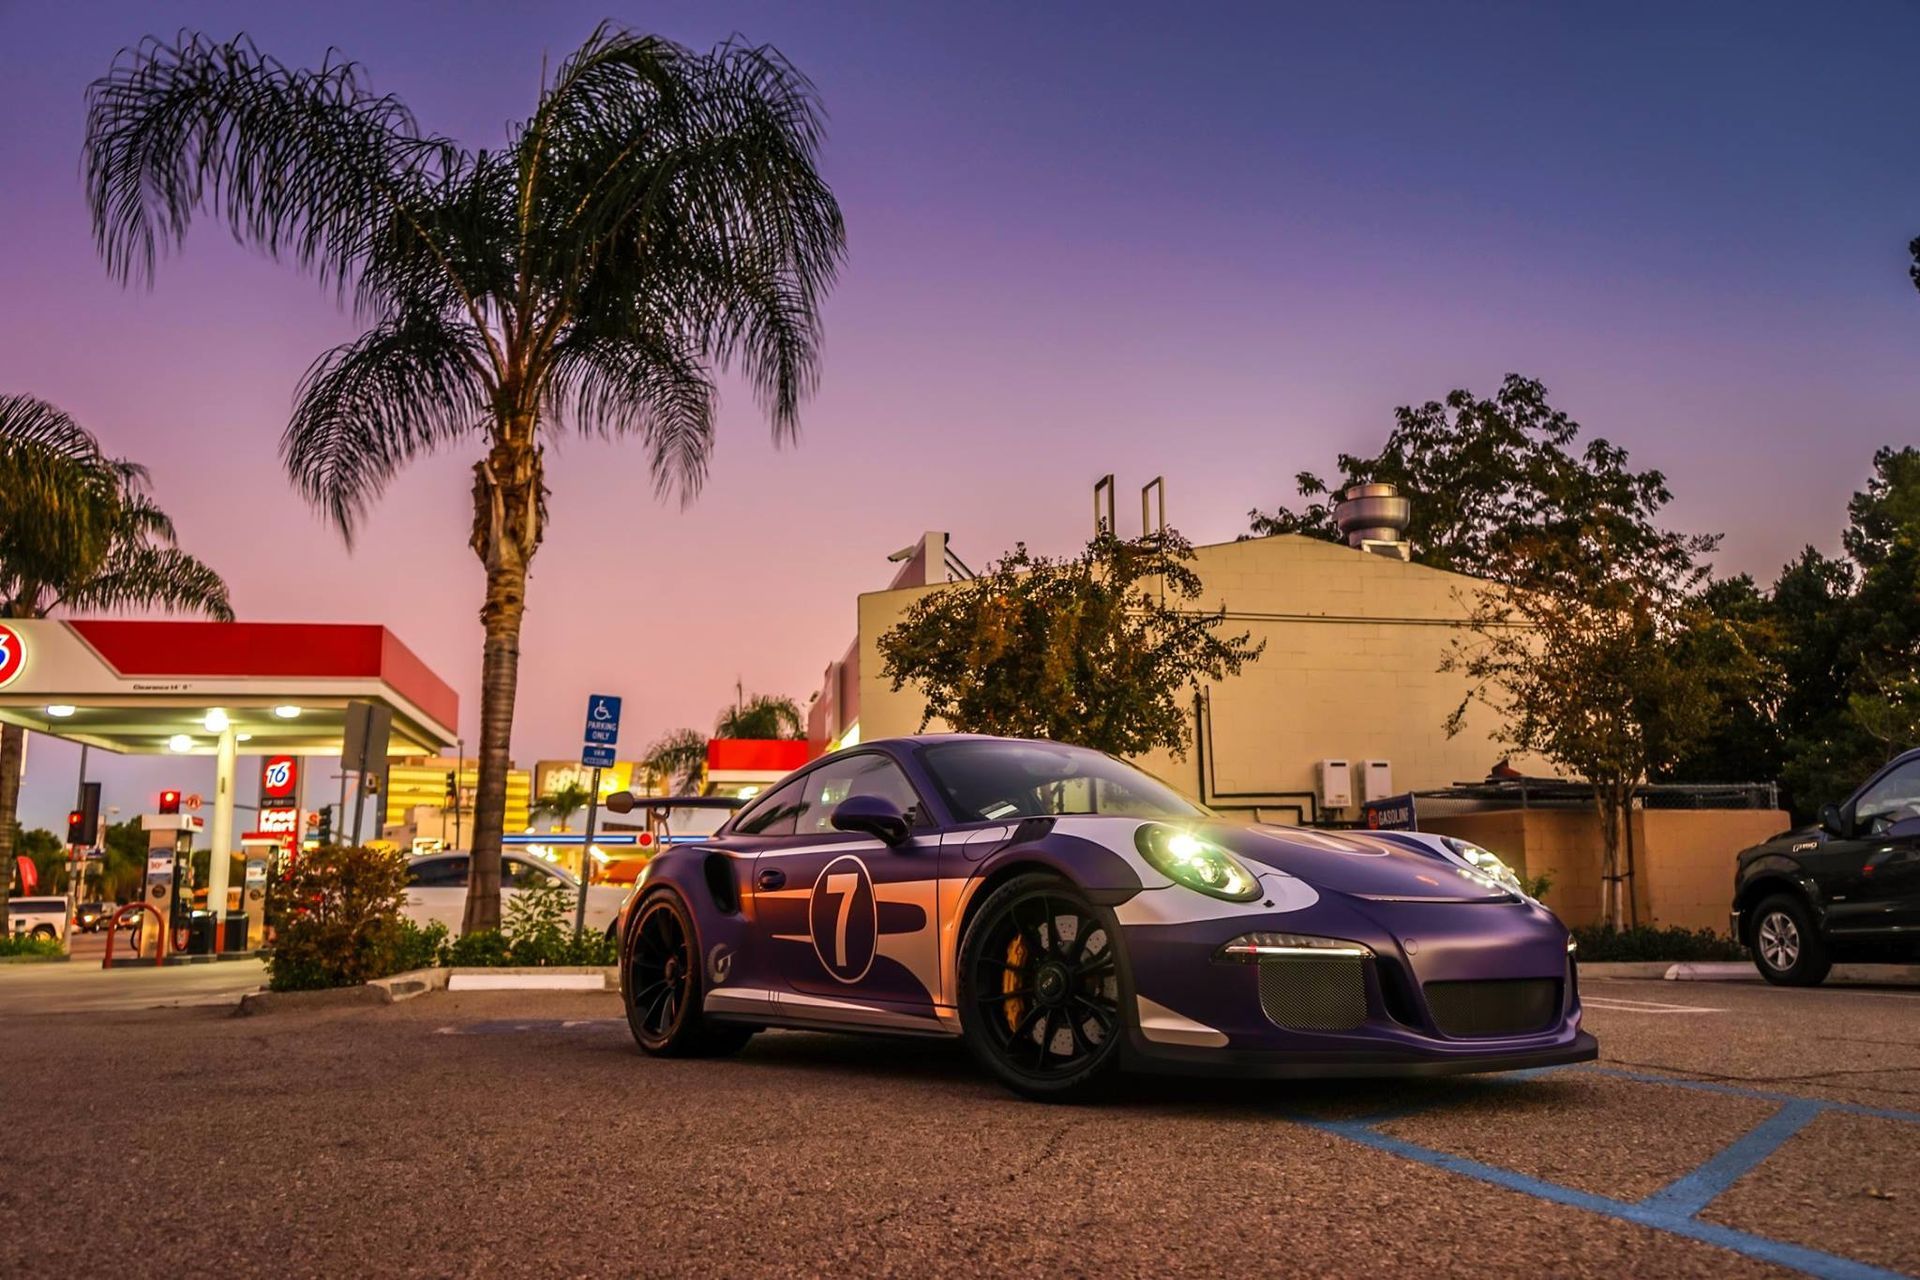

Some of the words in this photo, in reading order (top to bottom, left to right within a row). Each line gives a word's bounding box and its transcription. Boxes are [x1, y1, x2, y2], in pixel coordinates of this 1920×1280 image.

[588, 721, 617, 731] PARKING
[592, 731, 610, 740] ONLY
[266, 762, 291, 788] 76
[261, 809, 297, 823] Food
[1379, 808, 1408, 825] GASOLINE
[260, 820, 295, 832] Mart
[826, 873, 858, 967] 7
